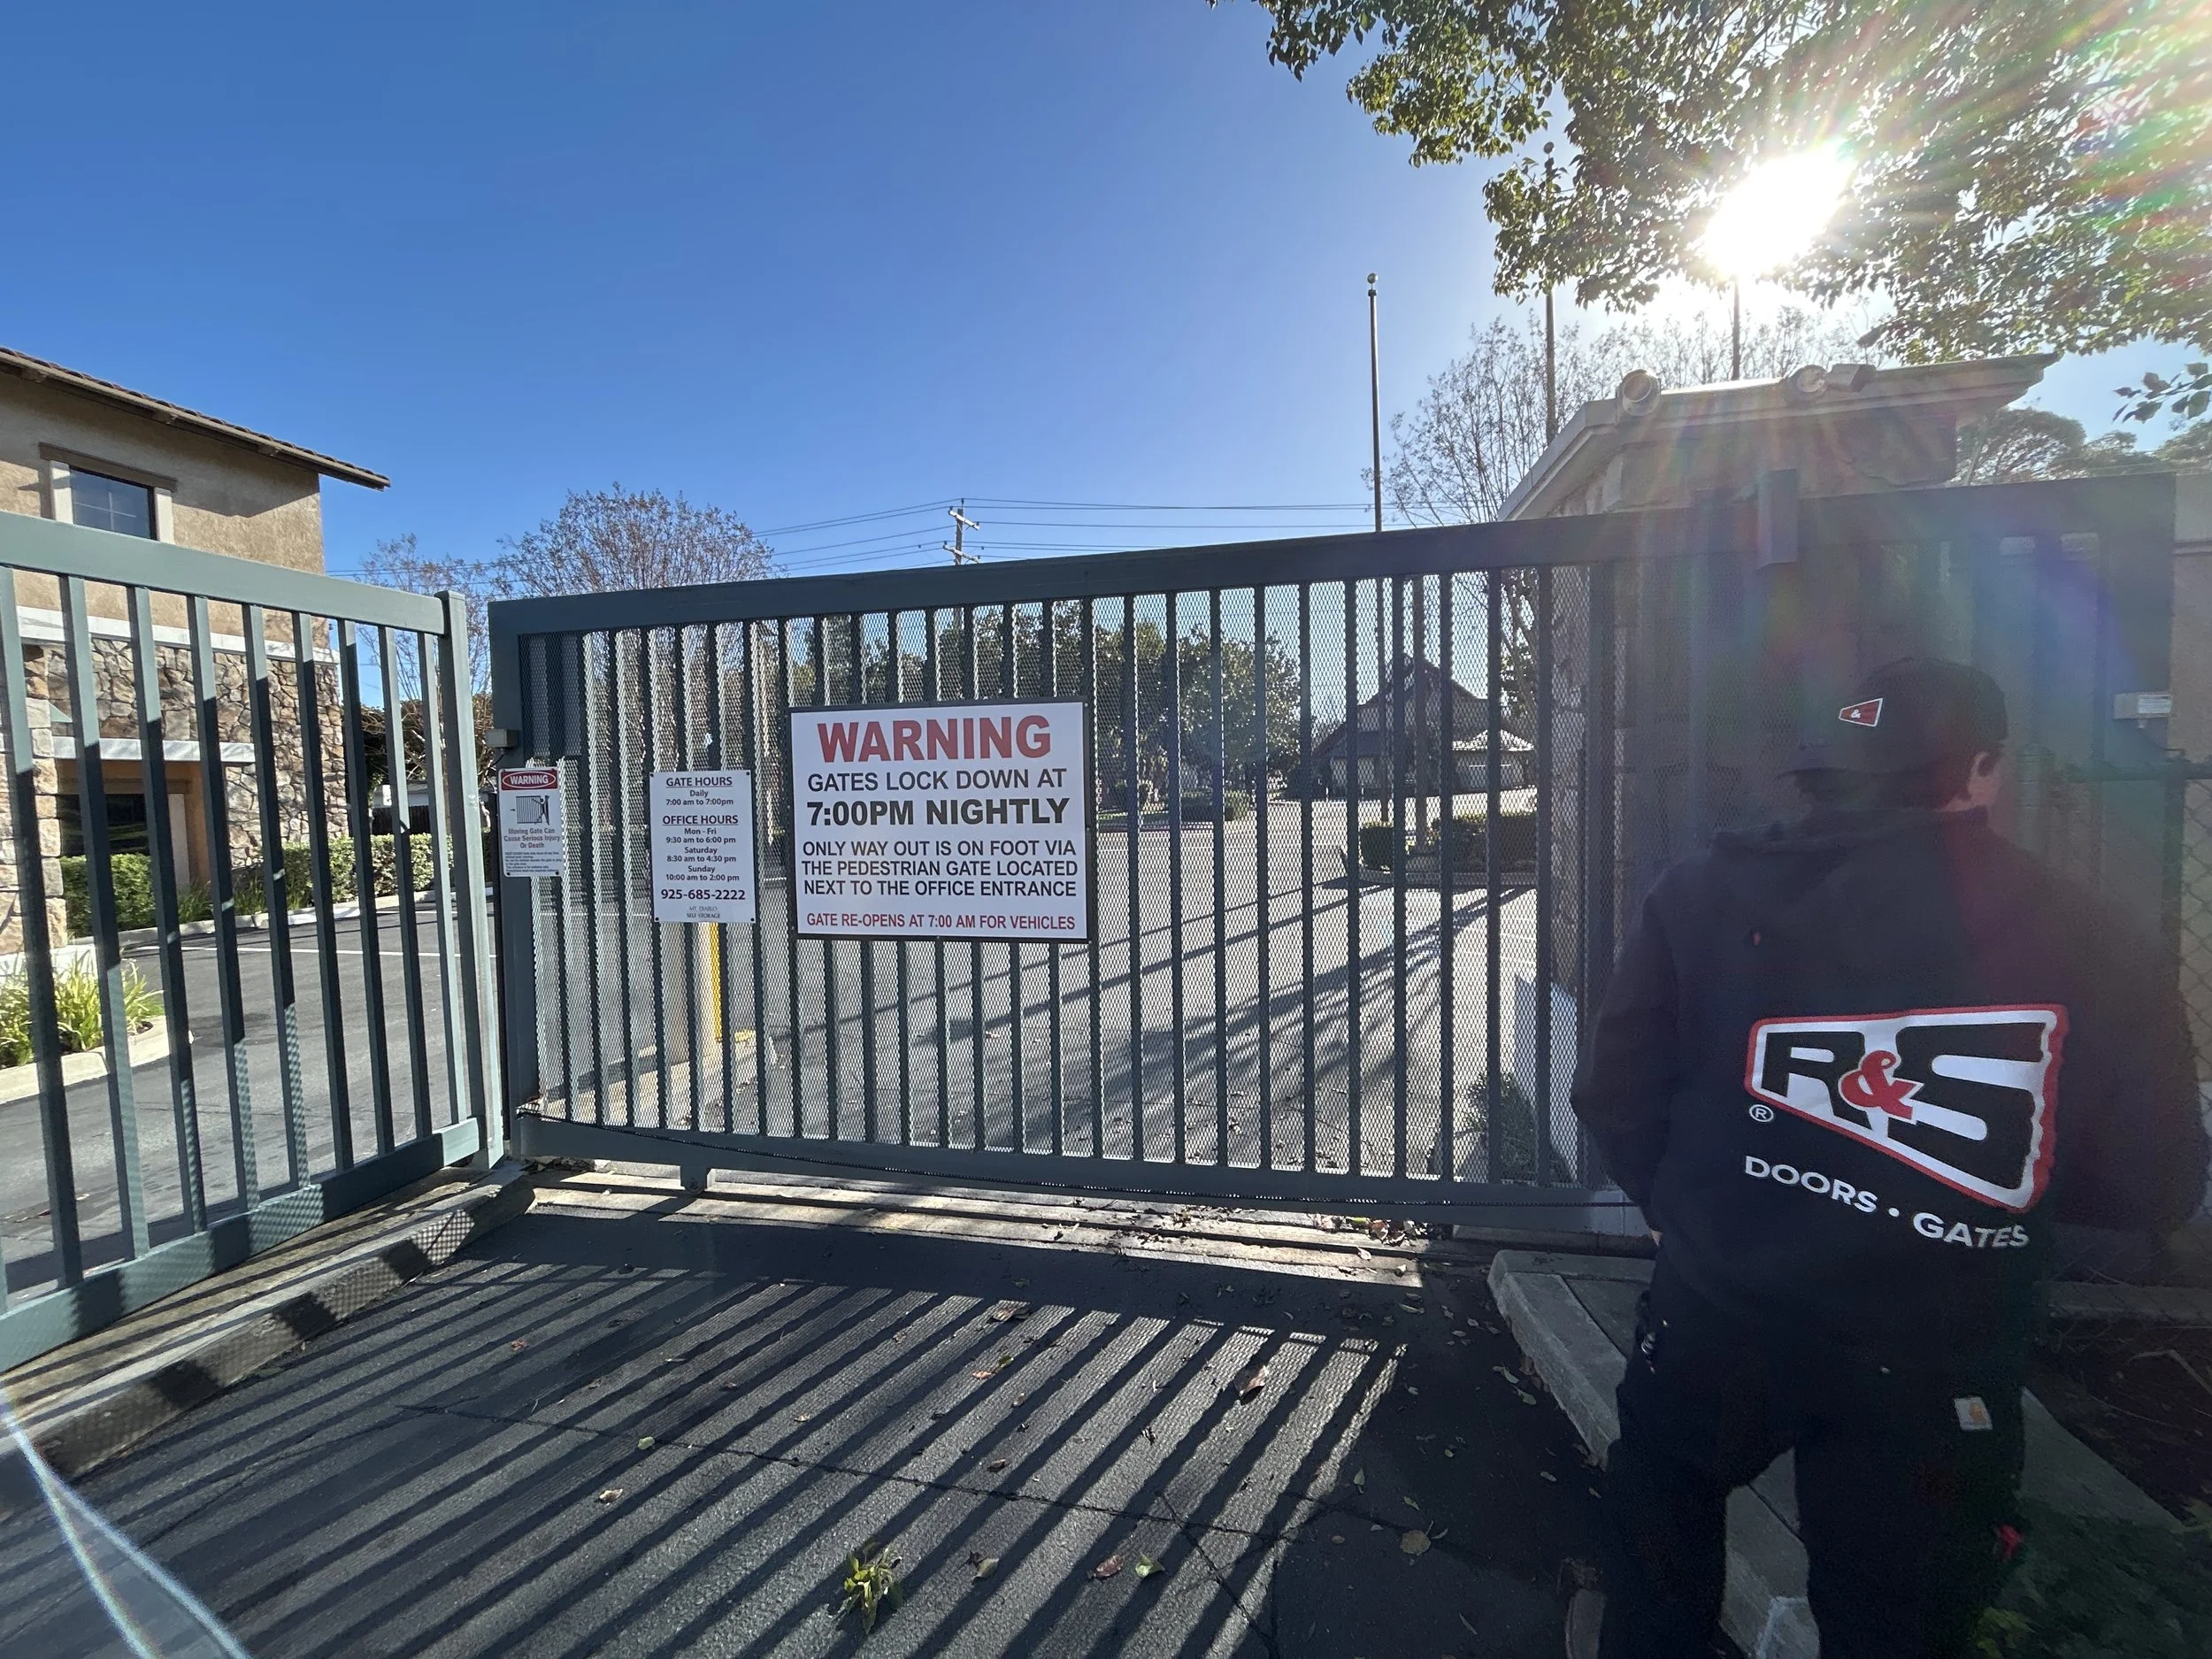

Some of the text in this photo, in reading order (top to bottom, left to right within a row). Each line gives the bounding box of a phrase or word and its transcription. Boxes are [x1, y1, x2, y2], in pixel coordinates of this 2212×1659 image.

[817, 715, 1051, 763] WARNING
[510, 775, 549, 785] WARNING
[666, 777, 733, 787] GATE HOURS
[808, 768, 1067, 792] GATES LOCK DOWN AT
[701, 815, 738, 824] HOURS
[807, 798, 1070, 826] 7:00PM NIGHTLY
[803, 841, 1076, 856] ONLY WAY OUT IS ON FOOT VIA
[802, 861, 1078, 876] THE PEDESTRIAN GATE LOCATED
[661, 889, 746, 900] 925-685-2222
[804, 880, 1076, 896] NEXT TO THE OFFICE ENTRANCE
[807, 913, 1075, 930] GATE RE-OPENS AT 7:00 AM FOR VEHICLES
[1761, 1021, 2047, 1191] R&S
[1745, 1156, 1878, 1213] DOORS
[1912, 1211, 2031, 1248] GATES
